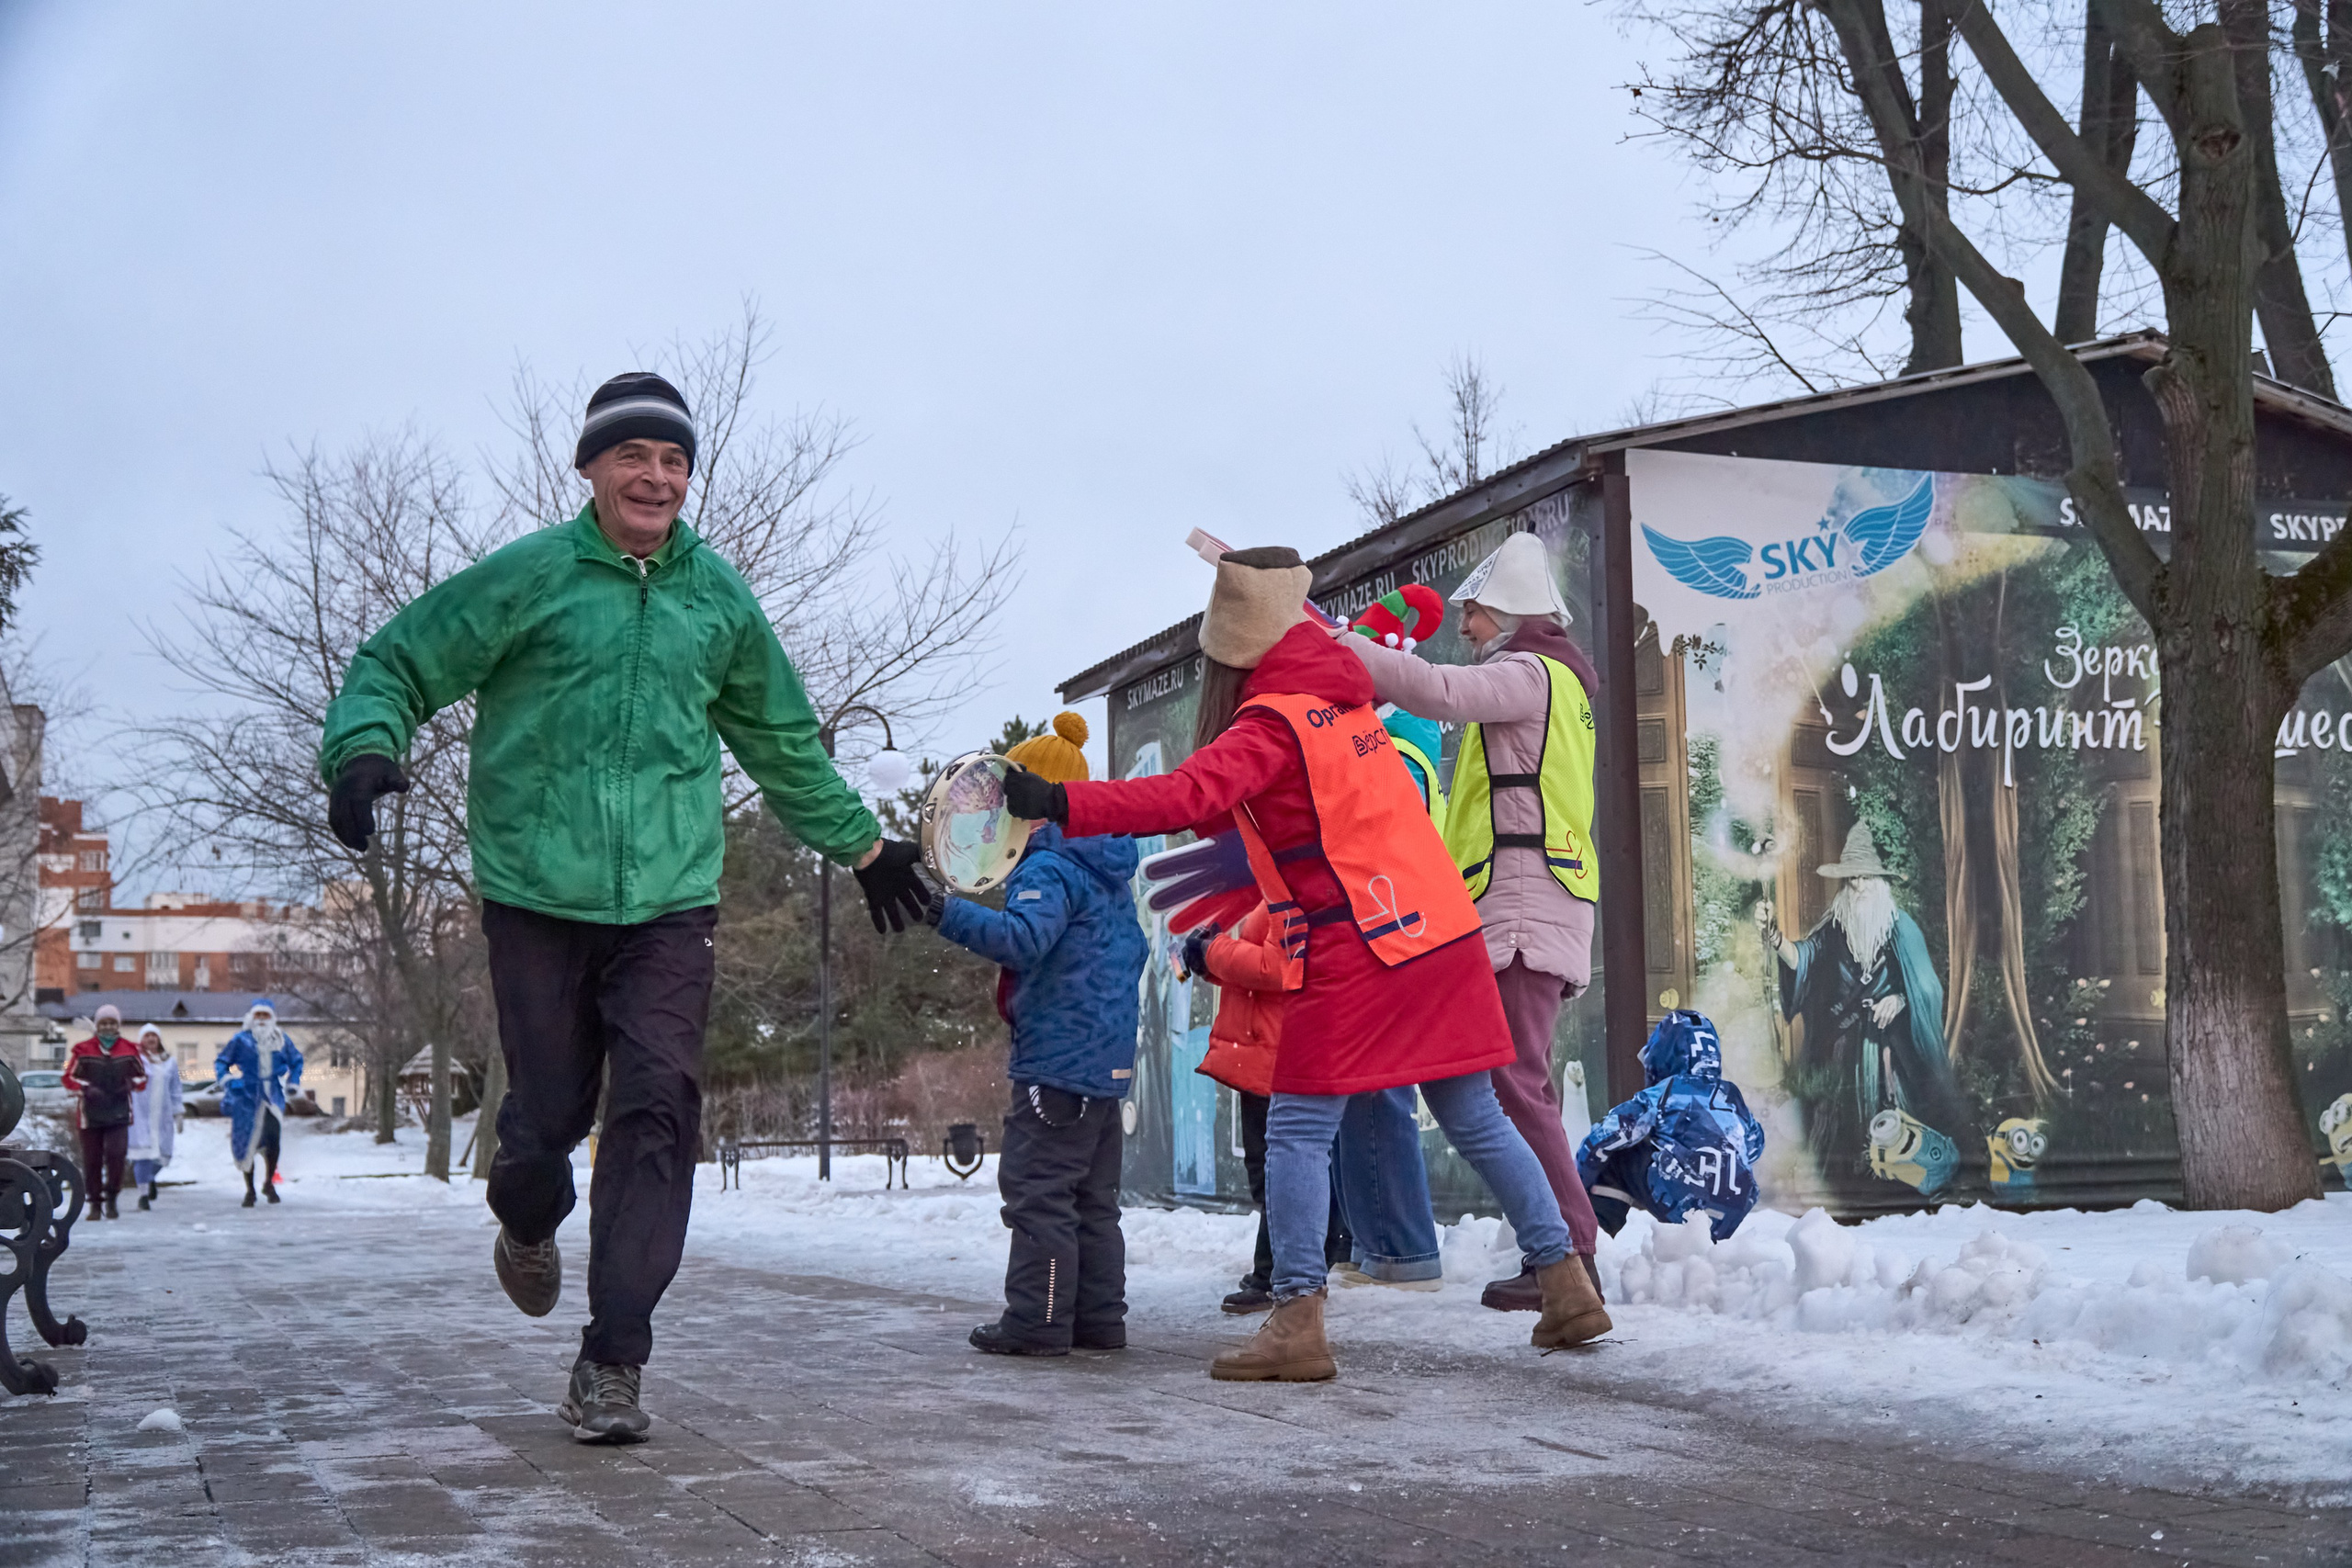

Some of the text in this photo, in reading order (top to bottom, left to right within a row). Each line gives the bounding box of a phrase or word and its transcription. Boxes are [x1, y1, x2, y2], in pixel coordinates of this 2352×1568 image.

[1760, 532, 1838, 580] SKY
[1317, 571, 1396, 618] KYMAZE.RU
[1766, 570, 1848, 595] PRODUCTION
[1127, 666, 1183, 710] SKYMAZE.RU
[1826, 672, 2146, 788] Лабиринт
